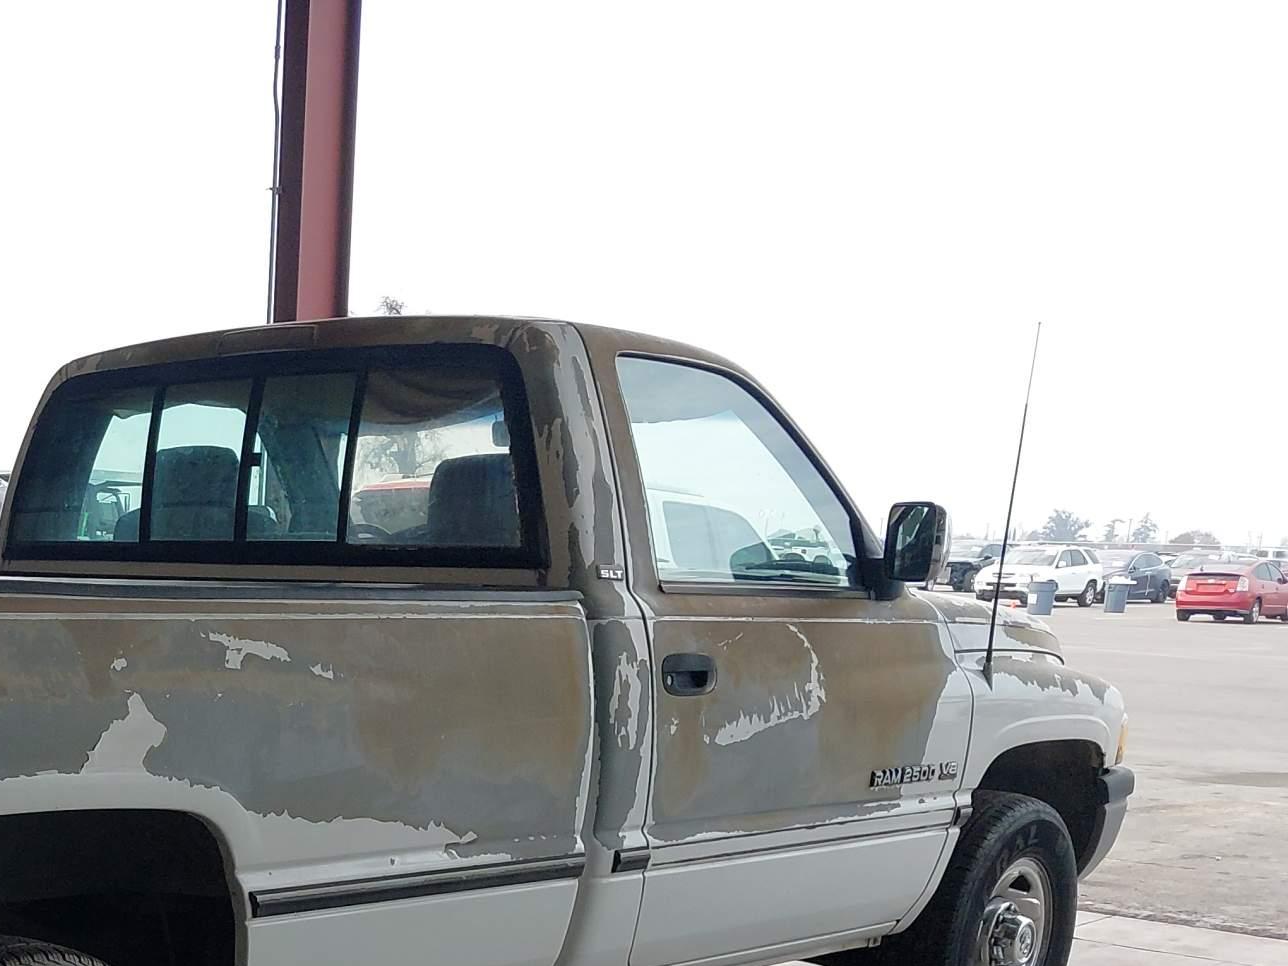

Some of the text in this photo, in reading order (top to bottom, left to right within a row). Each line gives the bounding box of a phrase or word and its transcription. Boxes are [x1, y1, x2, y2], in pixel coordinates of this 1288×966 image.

[600, 569, 623, 579] SLT
[871, 762, 958, 787] RAM 2500 V8
